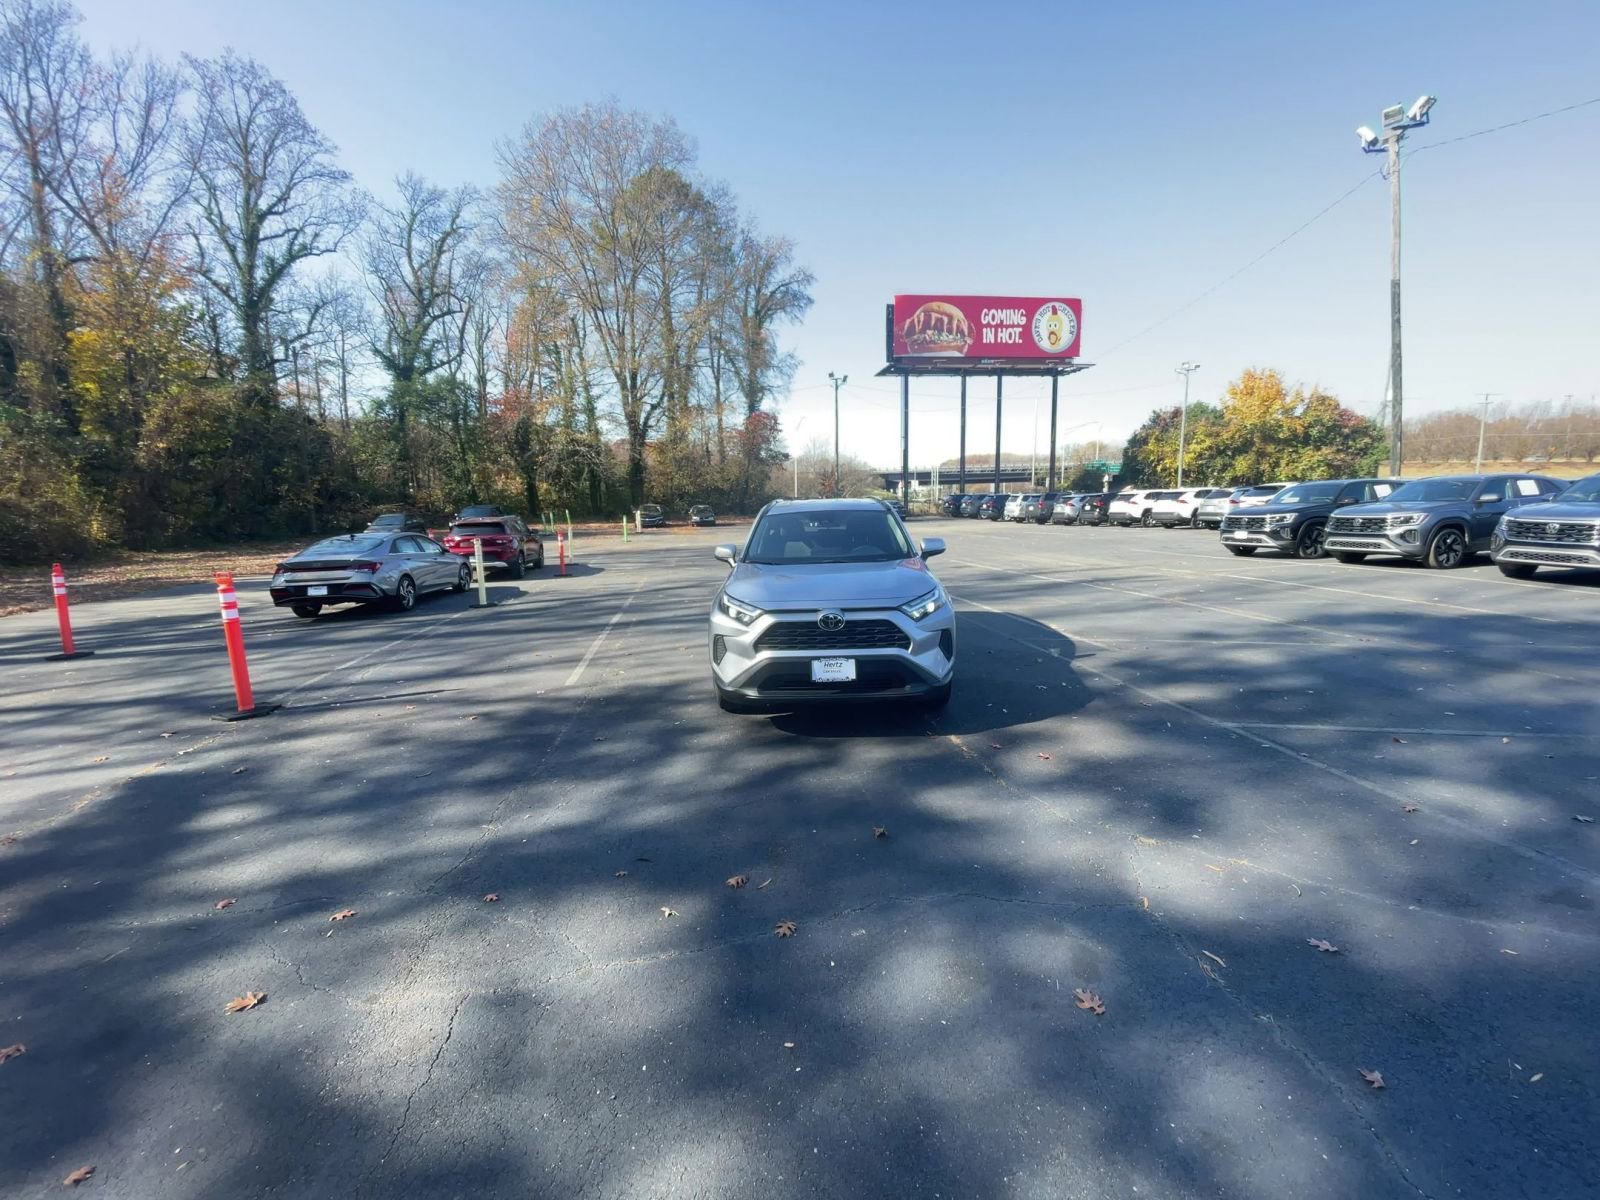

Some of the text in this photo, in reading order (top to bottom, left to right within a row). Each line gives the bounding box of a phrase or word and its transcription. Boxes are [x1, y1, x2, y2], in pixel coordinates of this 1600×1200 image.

[981, 309, 1026, 325] COMING
[1040, 305, 1050, 318] HOT
[1058, 305, 1075, 337] CHICKEN
[983, 327, 1022, 344] IN HOT.
